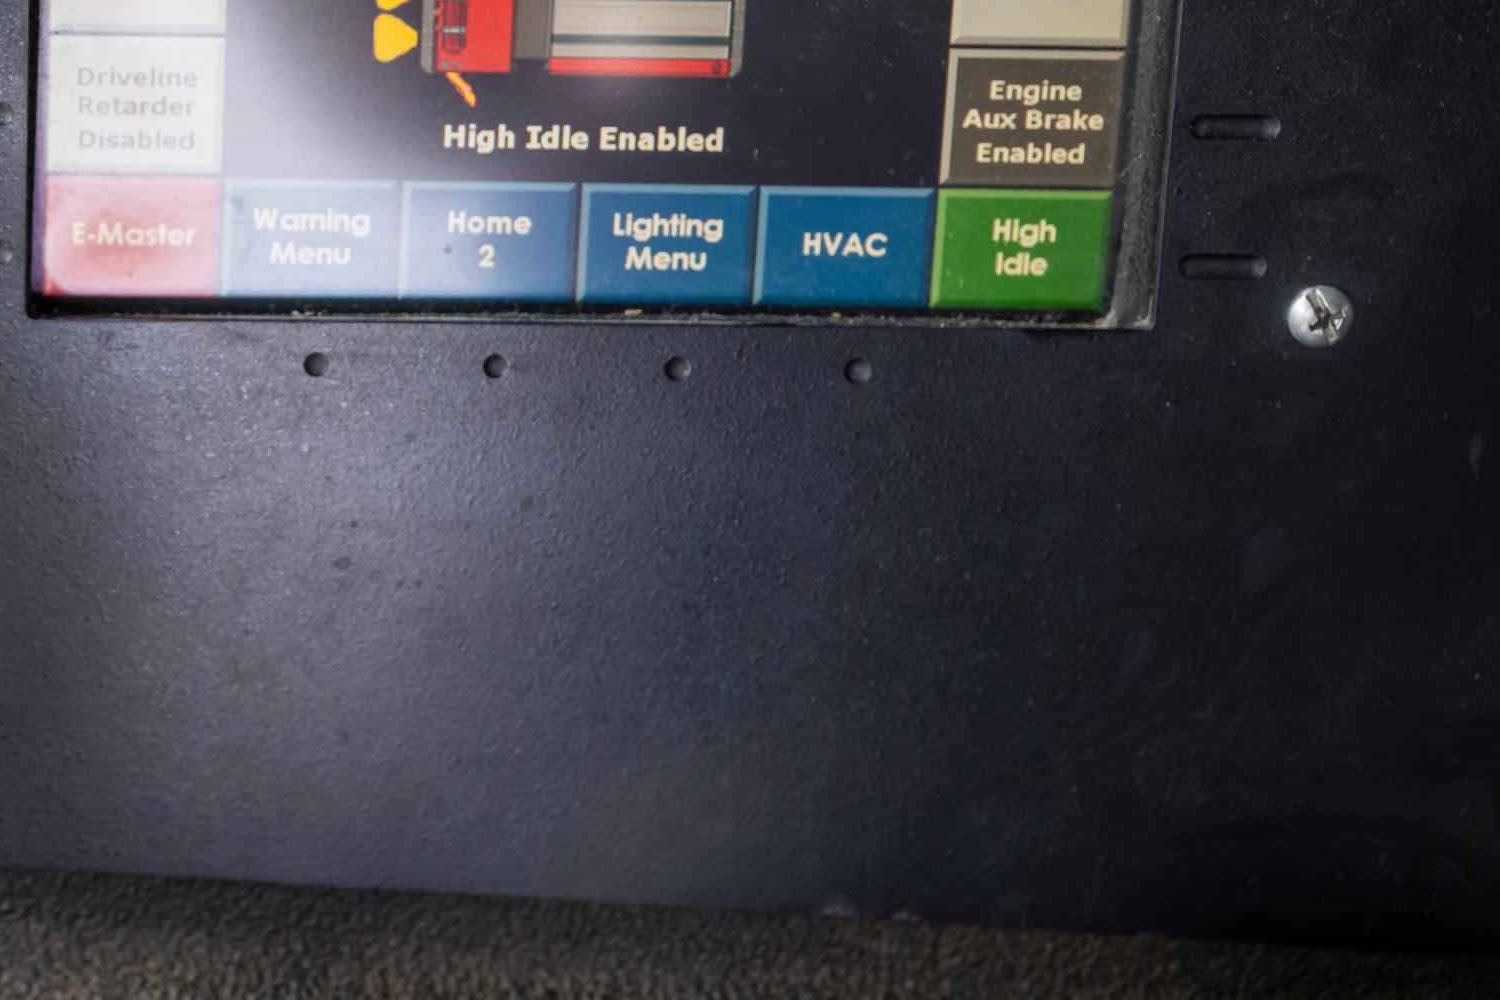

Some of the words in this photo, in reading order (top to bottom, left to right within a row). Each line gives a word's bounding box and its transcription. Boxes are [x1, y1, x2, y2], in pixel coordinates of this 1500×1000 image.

[77, 66, 199, 89] Driveline
[989, 80, 1083, 105] Engine
[77, 95, 197, 117] Retarder
[962, 109, 1016, 130] Aux
[1025, 109, 1104, 132] Brake
[77, 129, 196, 151] Disabled
[443, 124, 516, 154] High
[525, 125, 590, 151] Idle
[599, 126, 725, 153] Enabled
[975, 142, 1086, 165] Enabled
[71, 222, 195, 248] E-Master
[253, 208, 371, 237] Warning
[447, 210, 532, 235] Home
[612, 212, 724, 243] Lighting
[992, 218, 1057, 246] High
[269, 241, 351, 265] Menu
[477, 244, 495, 268] 2
[802, 232, 888, 258] HVAC
[624, 247, 707, 272] Menu
[995, 252, 1049, 277] Idle
